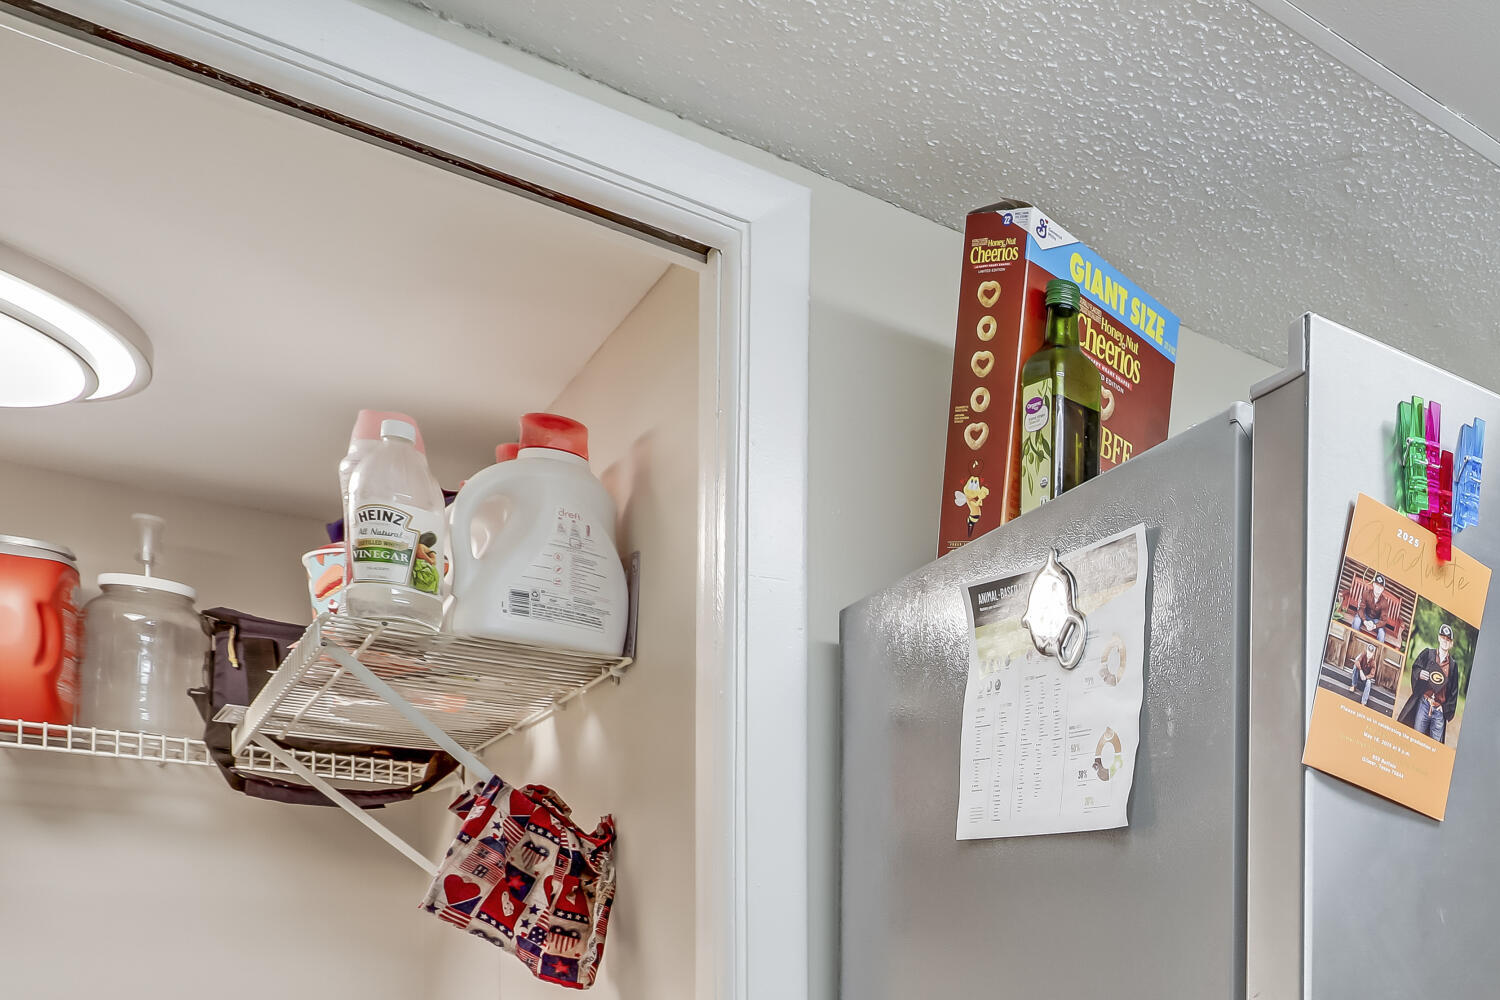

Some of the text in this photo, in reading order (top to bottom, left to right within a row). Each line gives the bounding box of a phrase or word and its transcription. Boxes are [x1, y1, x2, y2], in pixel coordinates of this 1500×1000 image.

[988, 240, 1006, 248] Honey
[970, 246, 1018, 264] Cheerios
[1070, 252, 1165, 346] GIANT SIZE
[1101, 317, 1124, 346] Honey
[1125, 334, 1139, 356] Nut
[1078, 312, 1141, 385] Cheerios
[1105, 377, 1125, 395] EDITION
[358, 510, 404, 526] HEINZ
[370, 528, 402, 538] Natural
[1396, 528, 1420, 548] 2025
[352, 548, 409, 562] VINEGAR
[978, 584, 1018, 605] ANIMAL-BASED
[1340, 704, 1356, 716] Please
[1363, 731, 1373, 740] May
